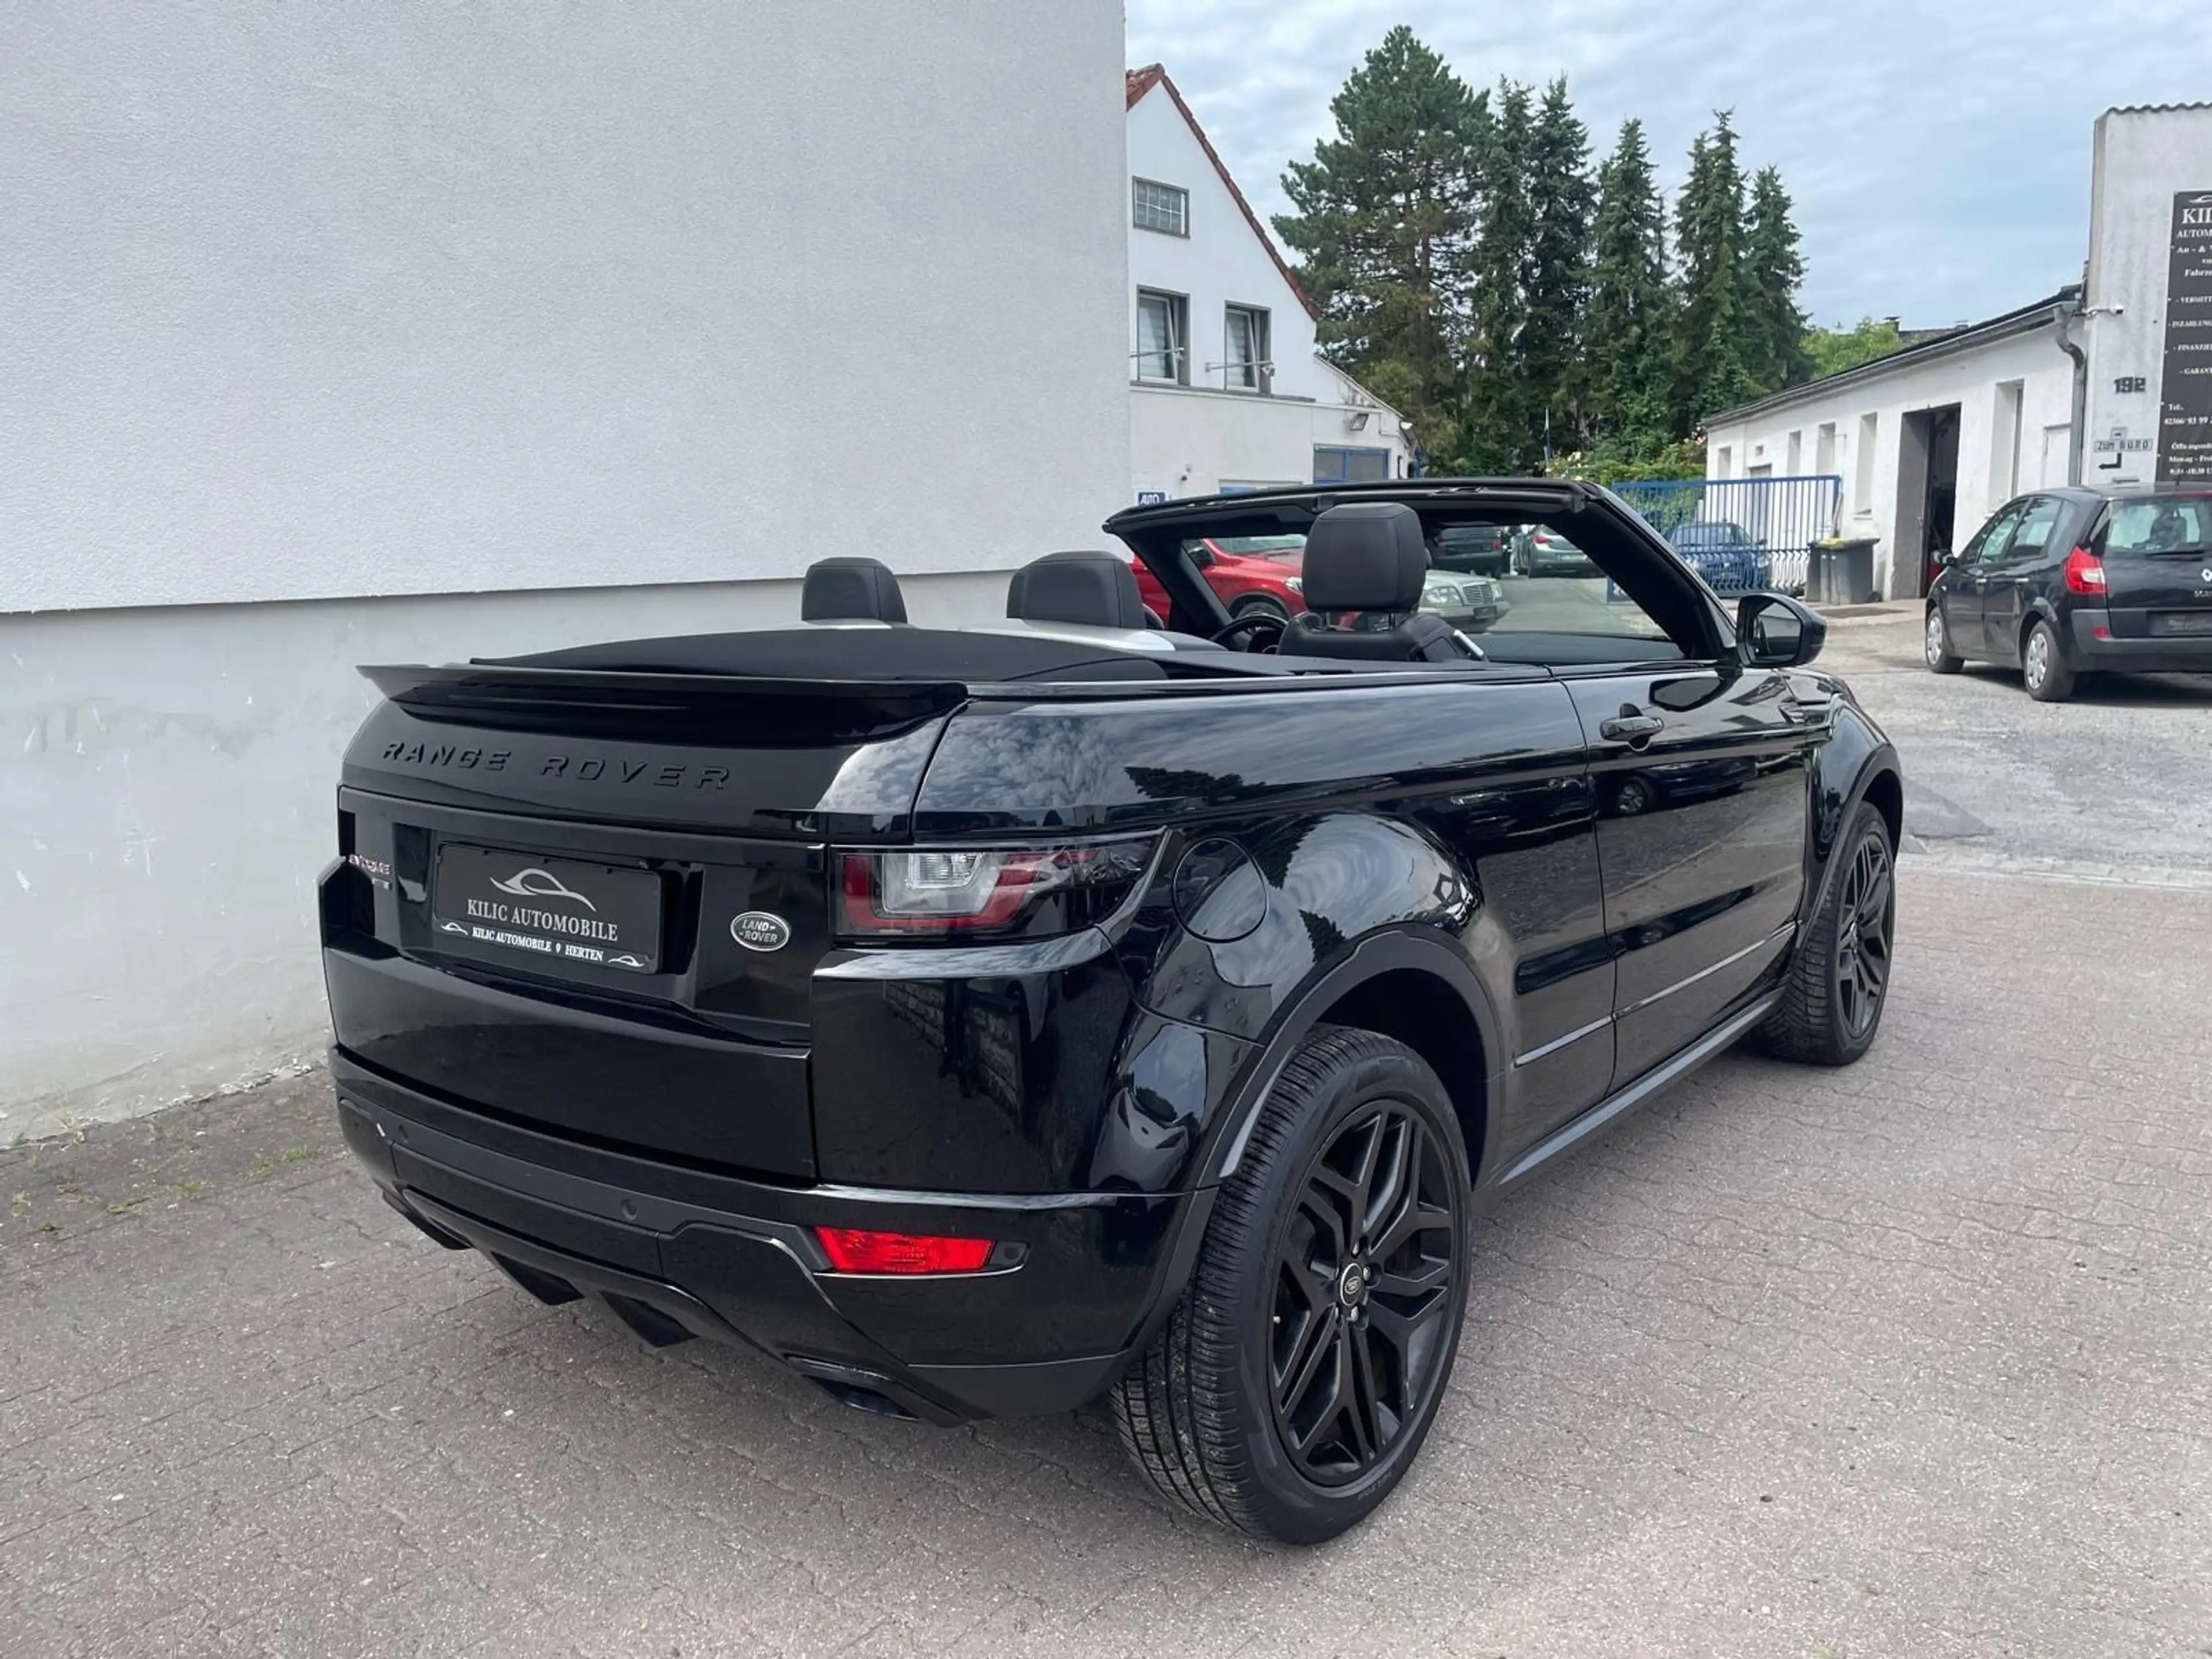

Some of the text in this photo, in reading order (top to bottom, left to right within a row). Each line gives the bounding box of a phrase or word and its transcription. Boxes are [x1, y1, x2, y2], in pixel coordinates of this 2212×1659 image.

[2114, 377, 2146, 393] 192
[382, 741, 730, 791] RANGE ROVER
[467, 899, 618, 941] KILIC AUTOMOBILE
[472, 926, 604, 962] KILIC AUTOMOBILE HERTEN
